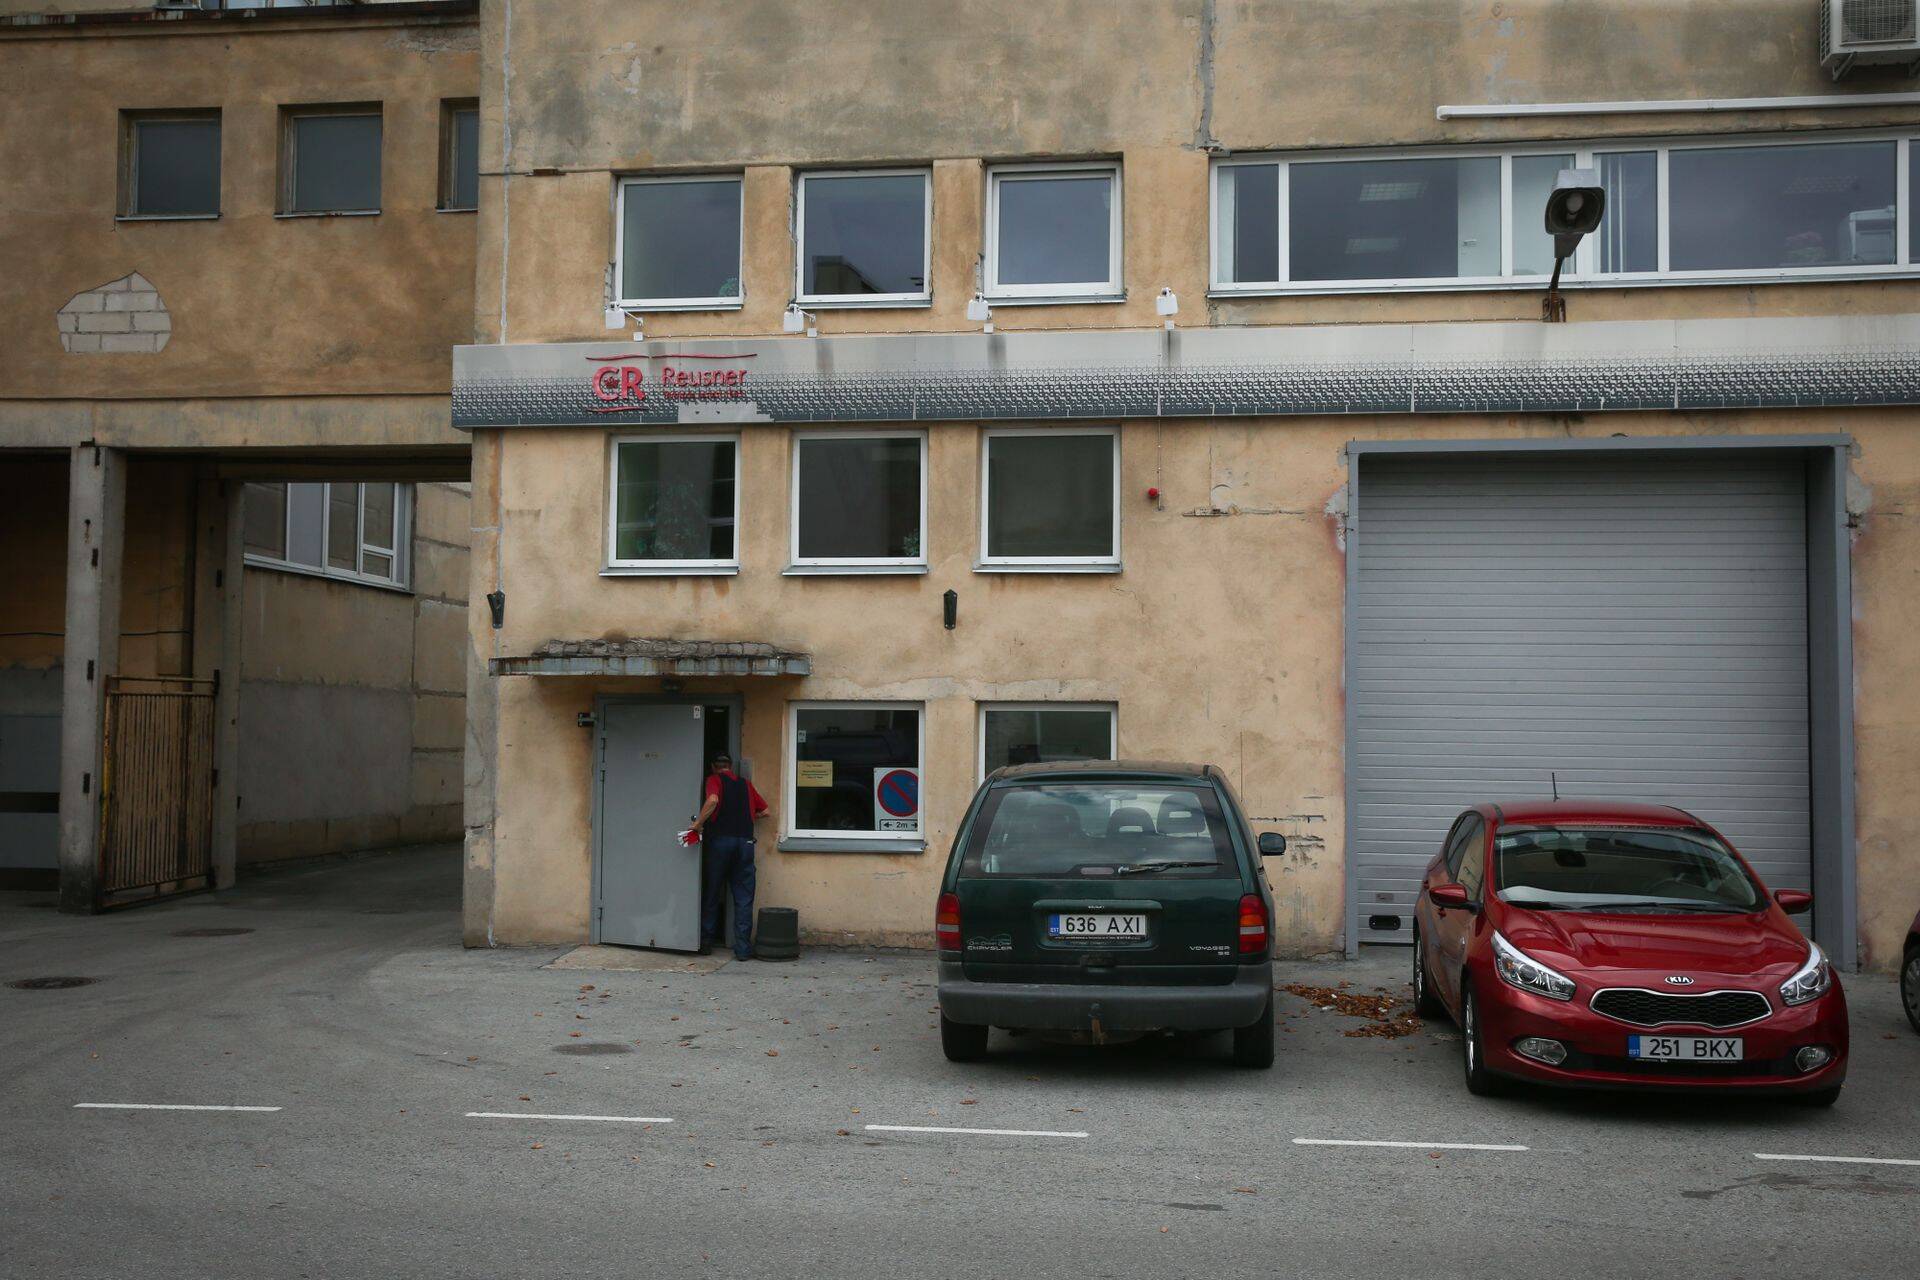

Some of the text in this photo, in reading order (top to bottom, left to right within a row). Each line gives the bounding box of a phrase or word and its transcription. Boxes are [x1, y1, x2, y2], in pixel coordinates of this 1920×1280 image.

[591, 366, 645, 402] CR
[661, 367, 748, 386] Reusner
[1066, 917, 1140, 933] 636 AXI
[1649, 1038, 1737, 1058] 251 BKX
